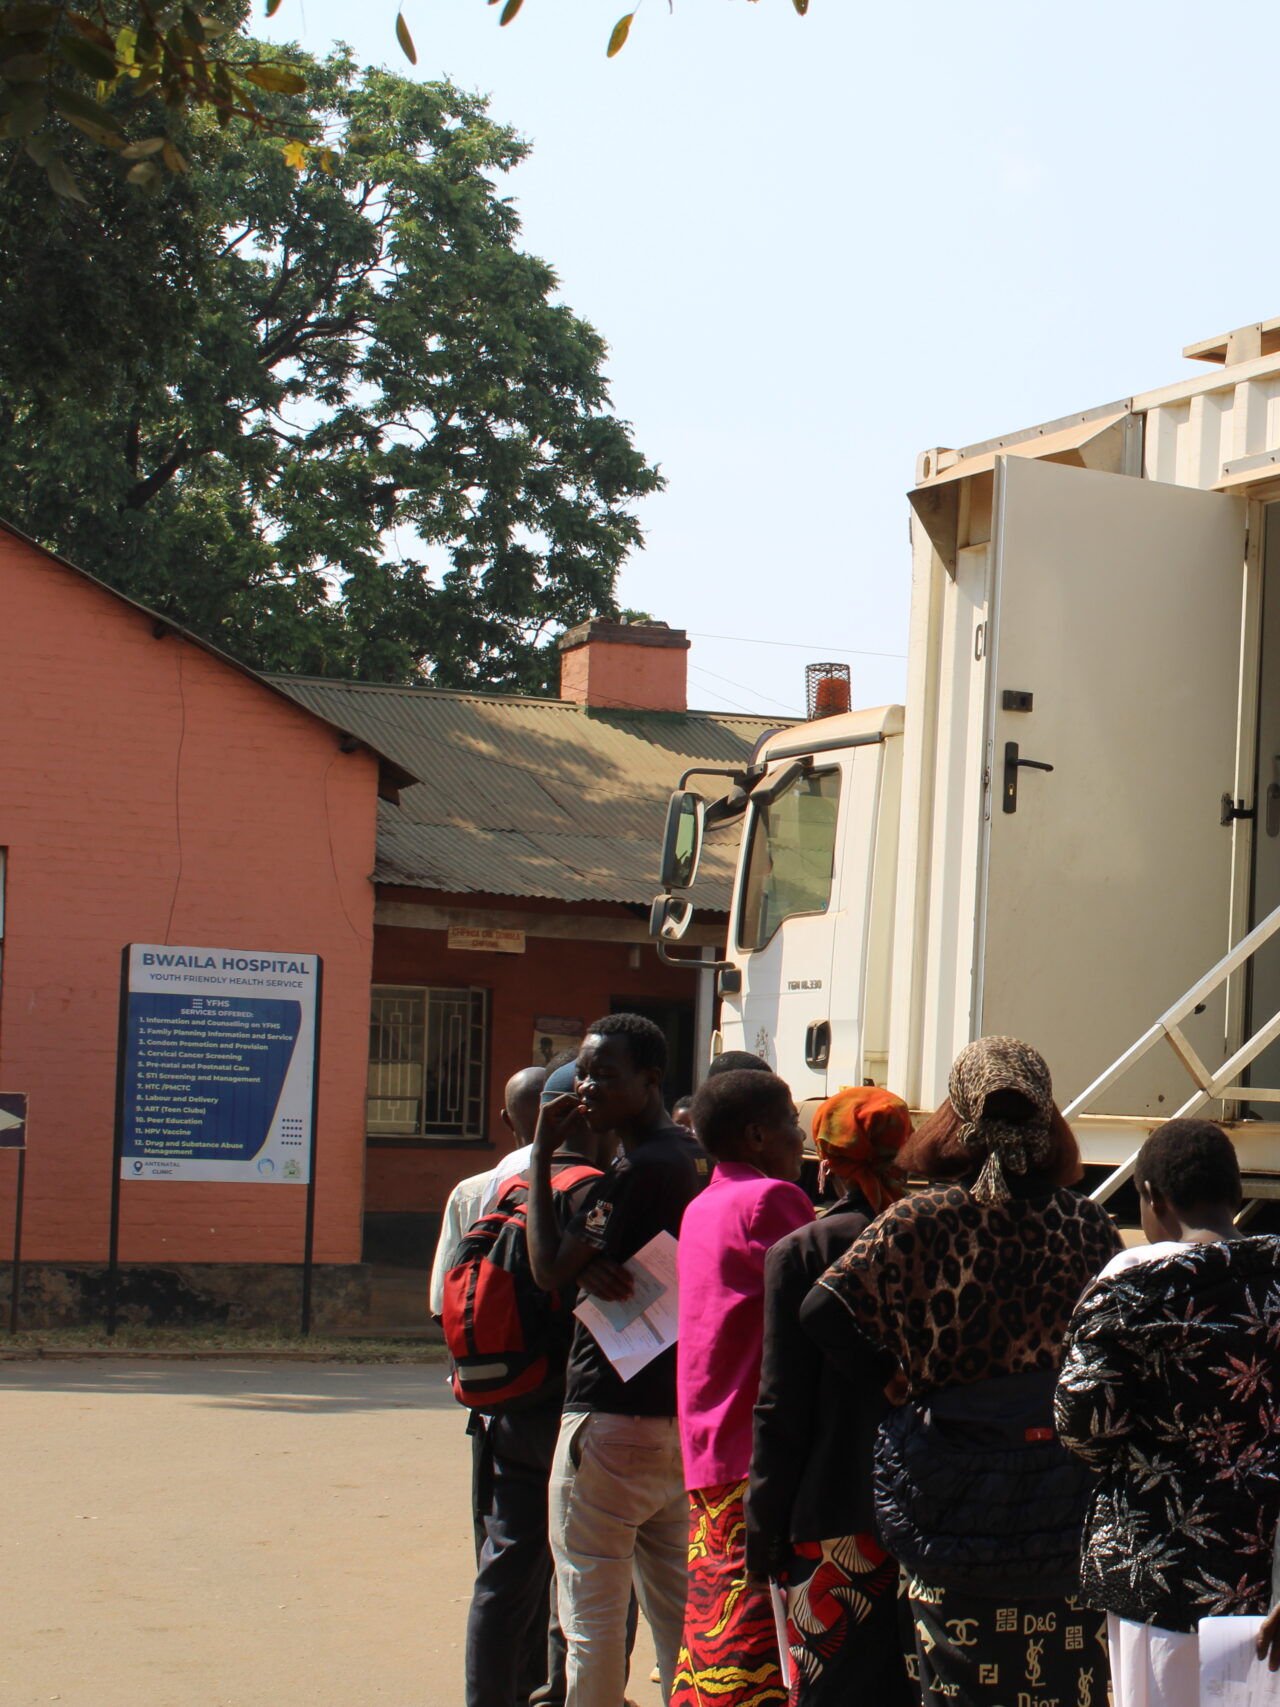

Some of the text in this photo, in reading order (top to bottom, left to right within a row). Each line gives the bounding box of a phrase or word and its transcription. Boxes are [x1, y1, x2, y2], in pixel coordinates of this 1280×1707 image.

[143, 953, 310, 974] BWAILA HOSPITAL
[150, 973, 304, 989] YOUTH FRIENDLY HEALTH SERVICE
[206, 999, 230, 1008] YFHS
[181, 1008, 216, 1016] SERVICES
[146, 1017, 190, 1025] Information
[147, 1028, 171, 1036] Family
[173, 1029, 206, 1037] Planning
[208, 1031, 250, 1039] Information
[206, 1053, 242, 1061] Screening
[197, 1063, 232, 1071] Postnatal
[159, 1073, 196, 1081] Screening
[213, 1075, 261, 1083] Management
[188, 1096, 219, 1104] Delivery
[1023, 1612, 1057, 1635] D&G
